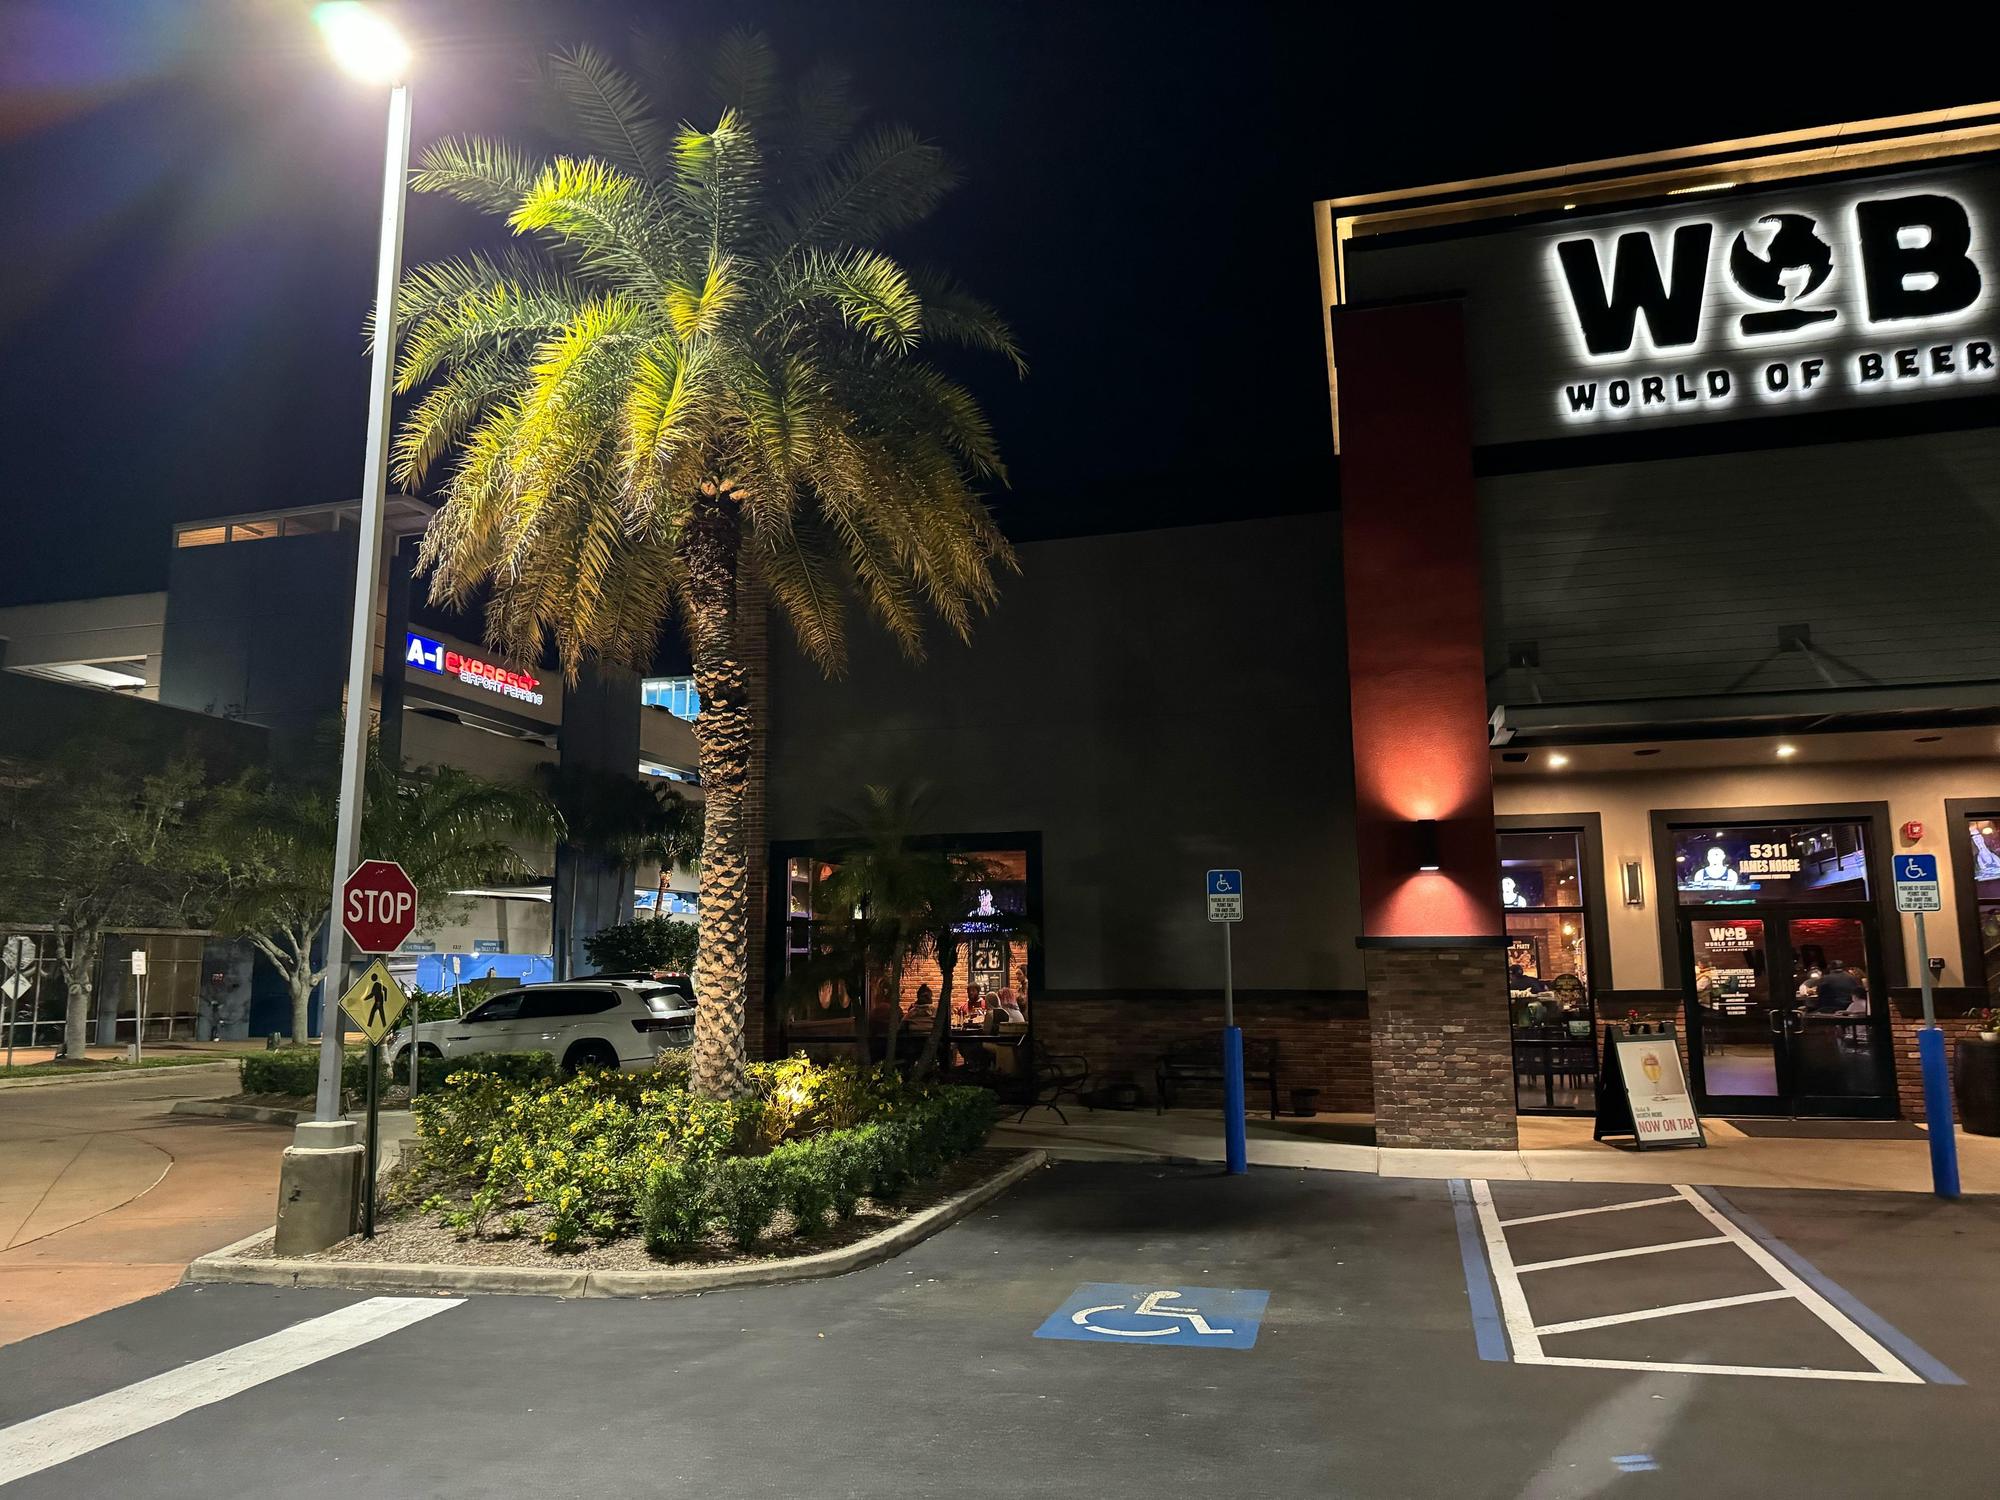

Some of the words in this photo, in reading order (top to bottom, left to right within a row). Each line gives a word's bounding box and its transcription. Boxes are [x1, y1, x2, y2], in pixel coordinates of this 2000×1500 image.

[1565, 369, 1731, 413] WORLD
[1765, 358, 1825, 393] OF
[1857, 340, 1995, 384] BEER
[406, 638, 444, 672] A-1
[1749, 843, 1788, 859] 5311
[347, 888, 412, 925] STOP
[1637, 1120, 1661, 1134] NOW
[1662, 1119, 1677, 1132] ON
[1677, 1118, 1695, 1131] TAP
